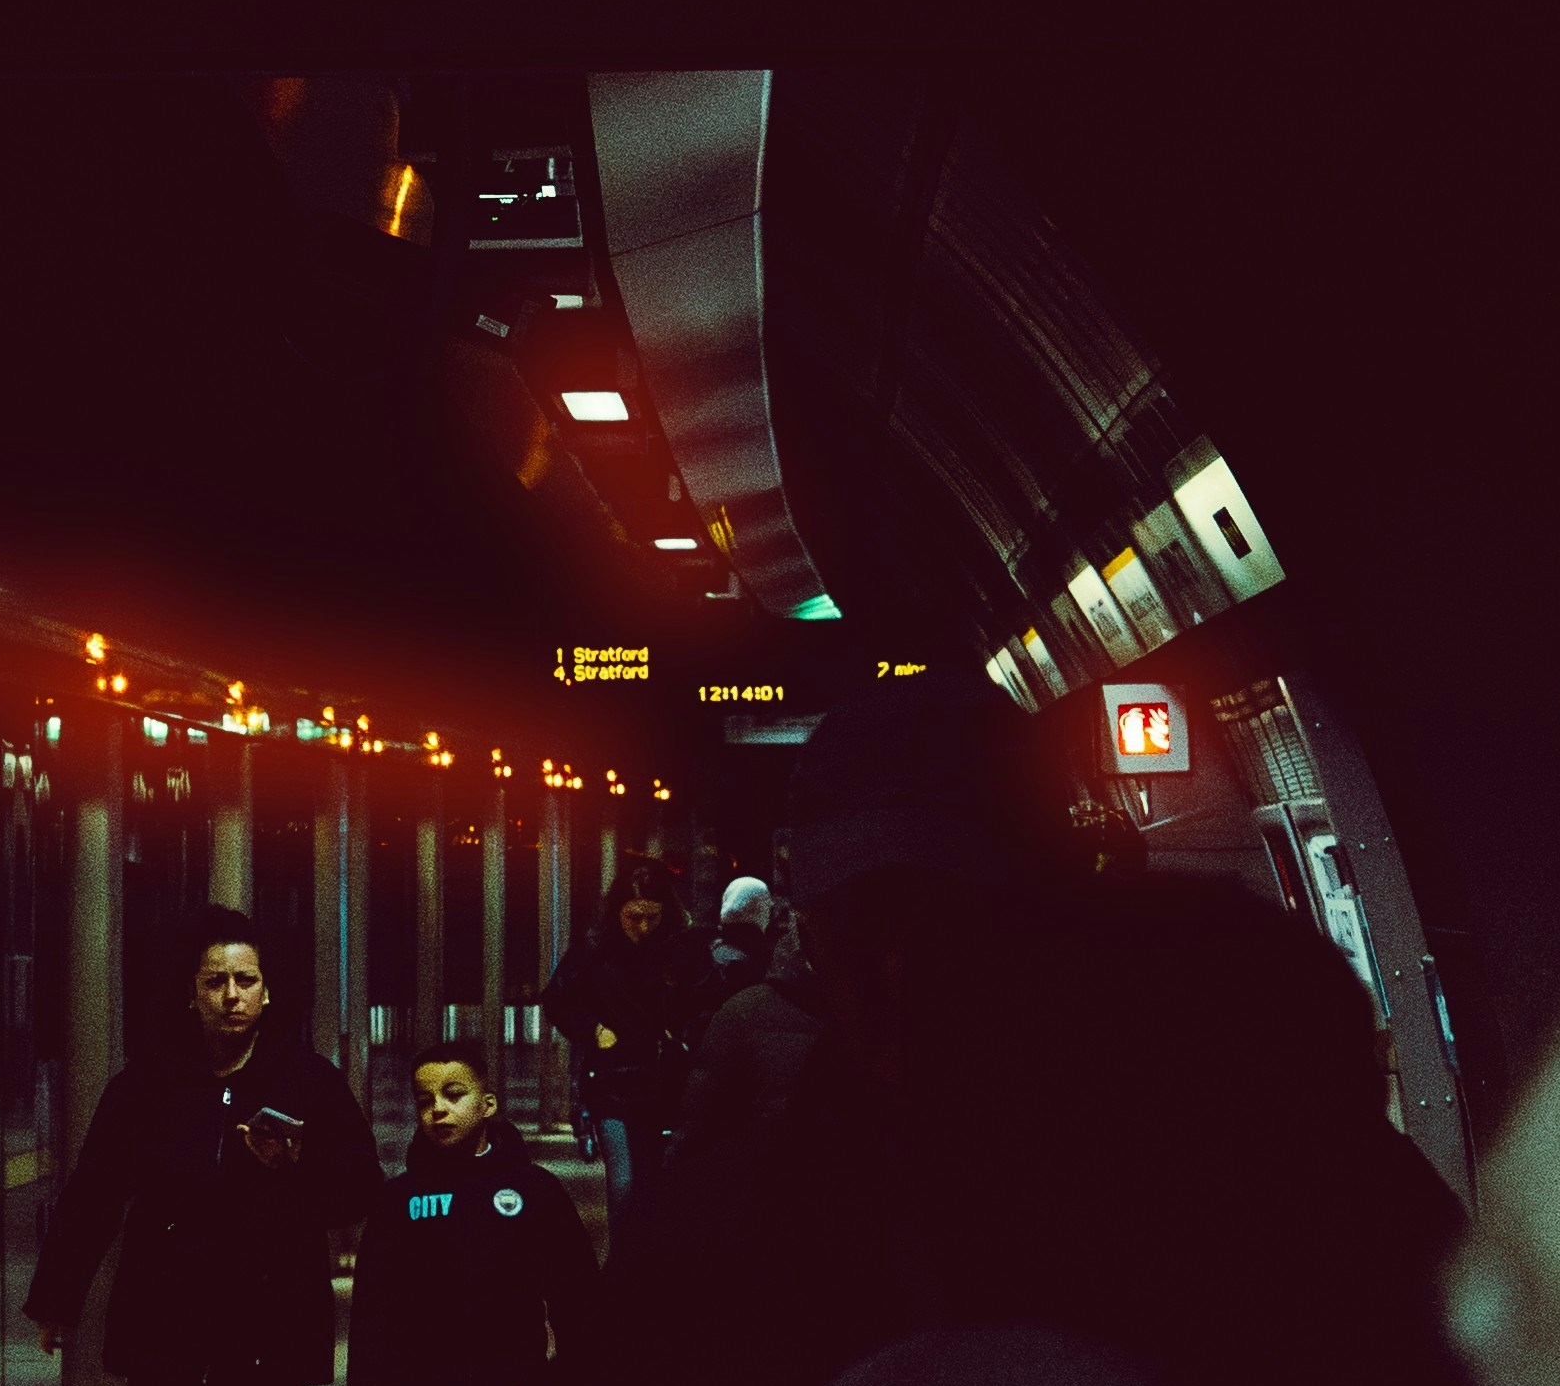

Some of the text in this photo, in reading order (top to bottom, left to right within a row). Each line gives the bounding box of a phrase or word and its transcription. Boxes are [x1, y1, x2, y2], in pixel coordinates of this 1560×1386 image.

[556, 646, 649, 664] 1 Stratford
[573, 664, 649, 682] Stratford
[698, 685, 784, 702] 12:14:01
[408, 1193, 454, 1221] CITY
